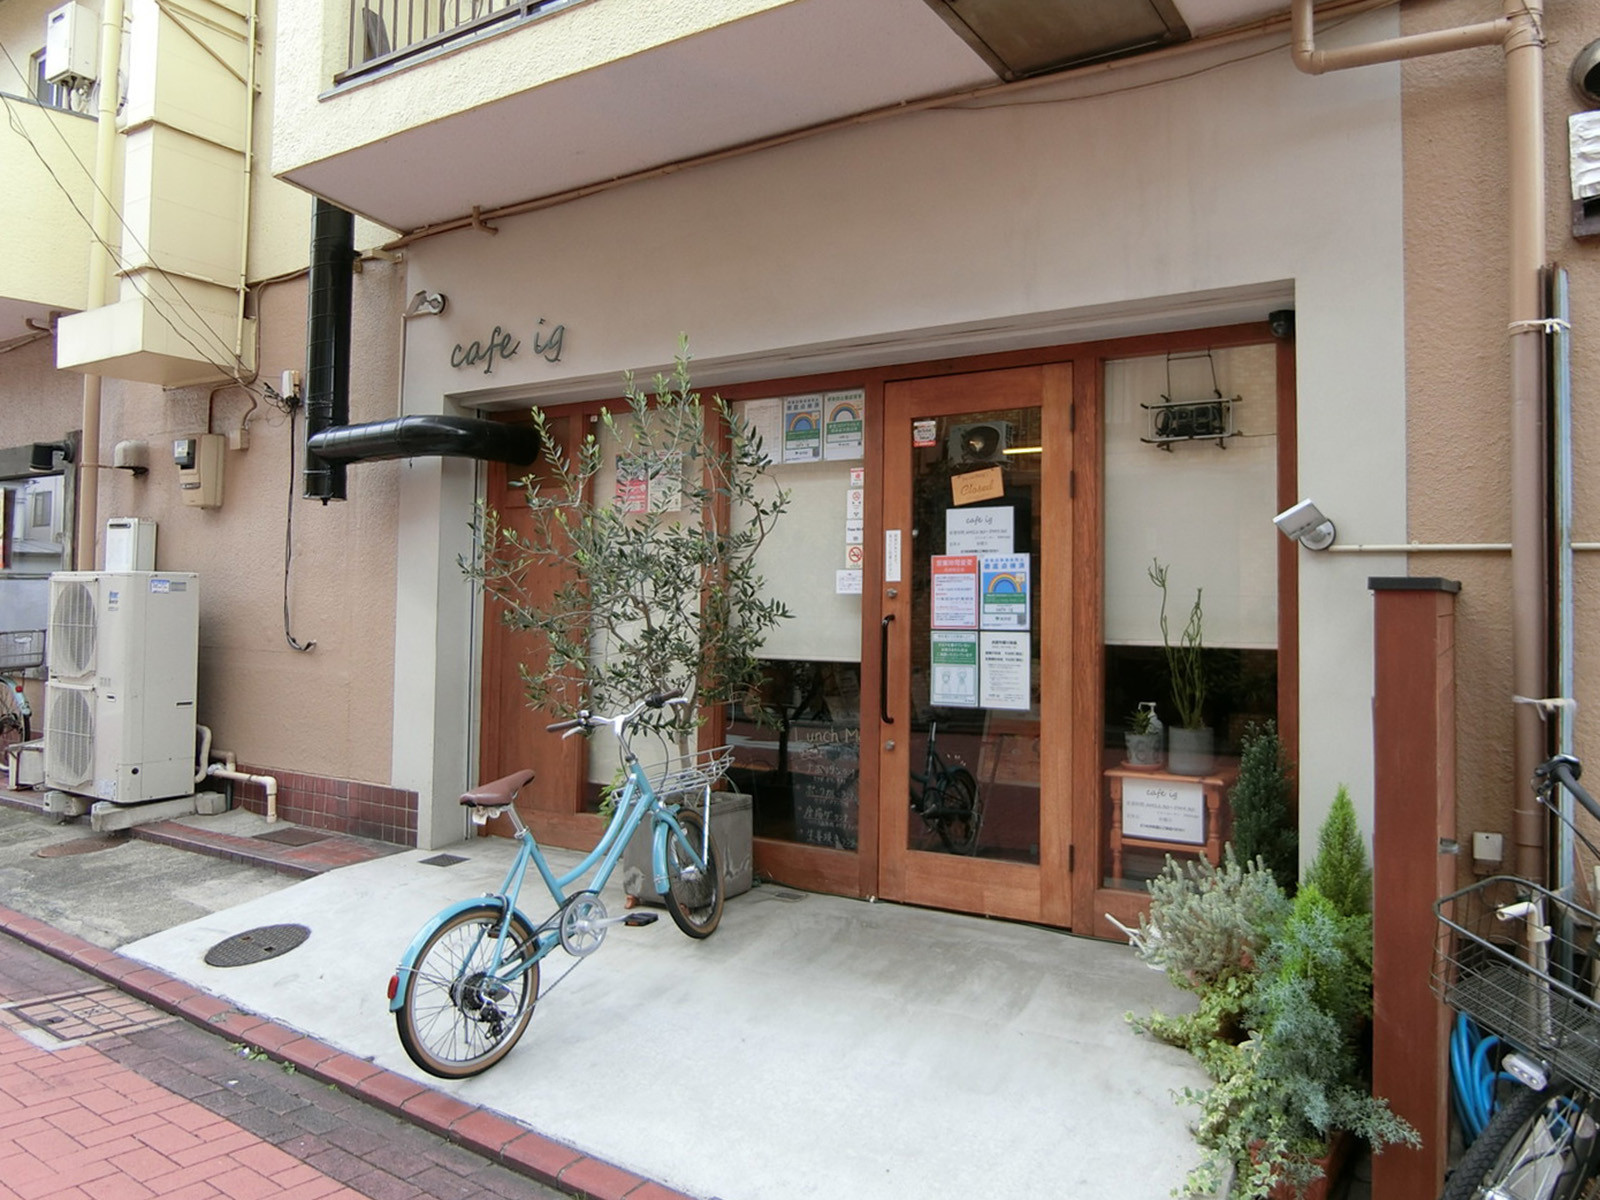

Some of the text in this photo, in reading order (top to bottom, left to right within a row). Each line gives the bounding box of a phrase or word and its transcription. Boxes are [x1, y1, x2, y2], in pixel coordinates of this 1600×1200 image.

[451, 318, 566, 374] cafe ig
[960, 479, 995, 496] Closed
[966, 515, 993, 526] cafe ig
[1146, 788, 1178, 800] cafe ig
